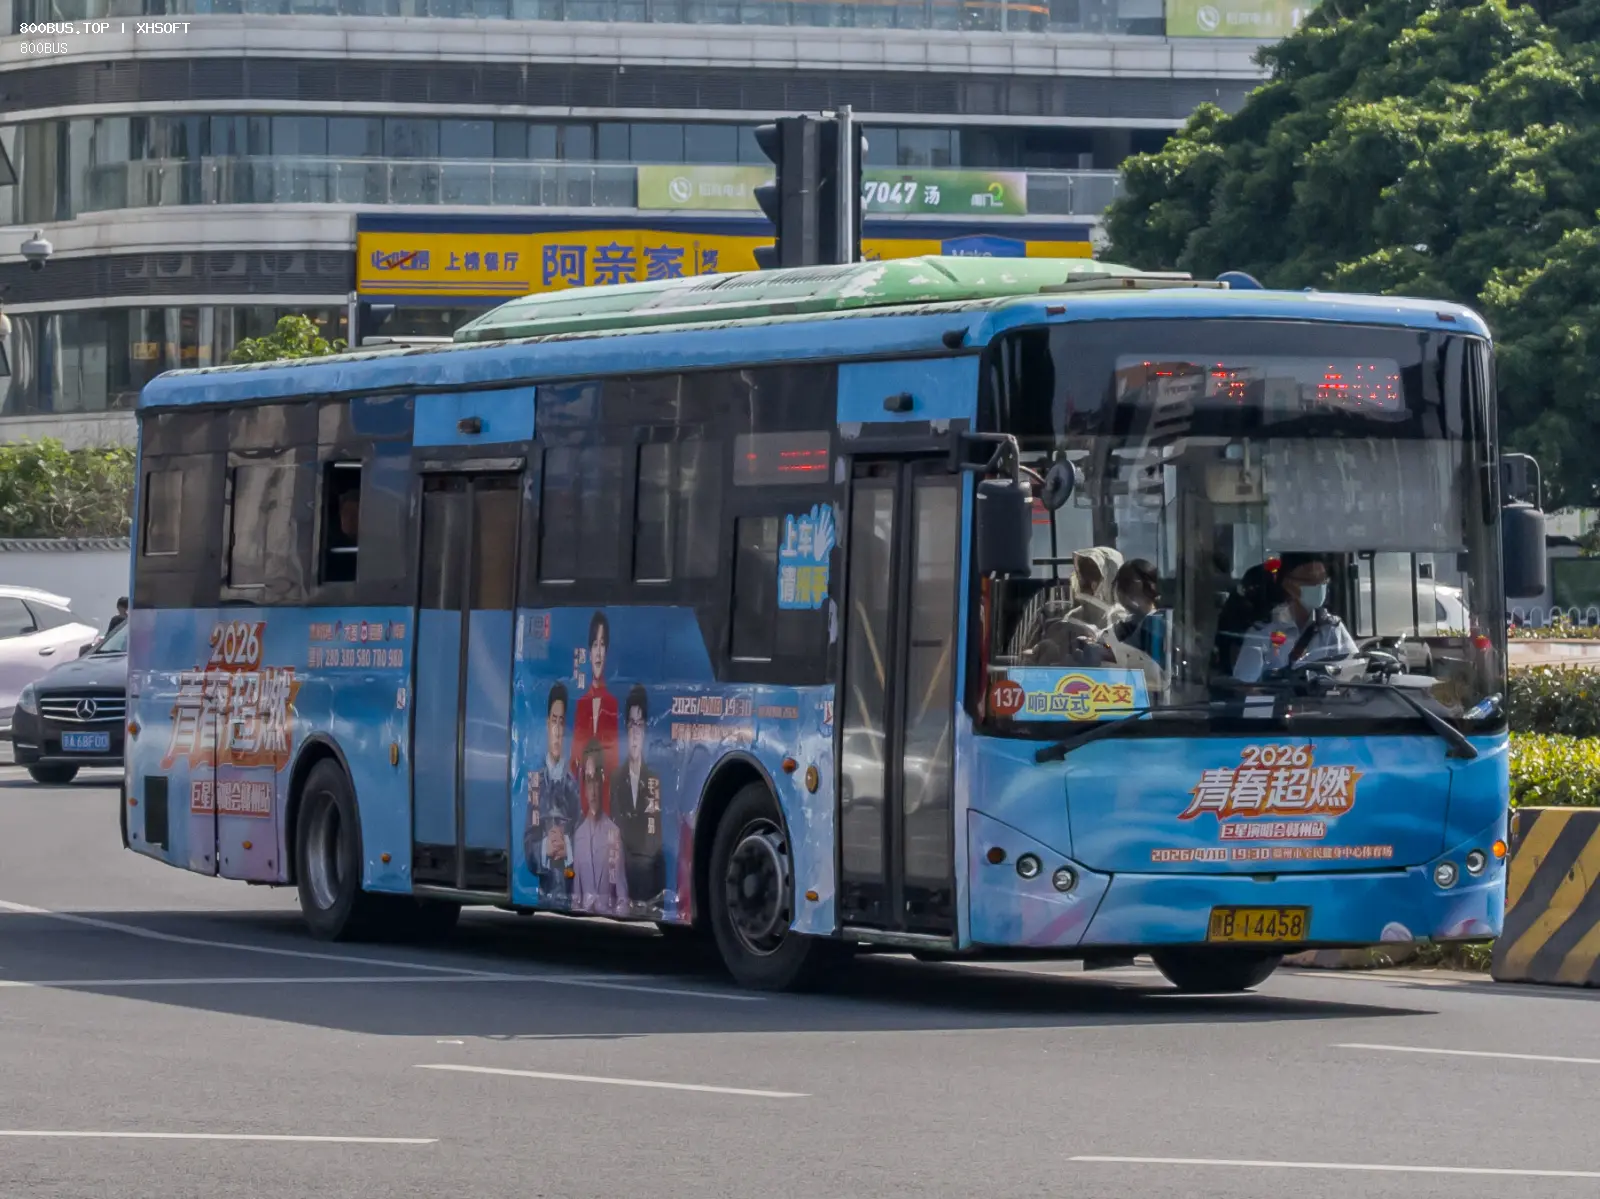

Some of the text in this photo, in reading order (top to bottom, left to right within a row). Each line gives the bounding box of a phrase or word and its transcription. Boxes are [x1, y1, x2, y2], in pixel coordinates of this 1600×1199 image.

[542, 241, 685, 287] 阿亲家
[781, 519, 813, 558] 上车
[211, 623, 259, 664] 2026
[168, 668, 291, 756] 青春超燃
[994, 688, 1022, 707] 137
[1243, 746, 1308, 766] 2026
[1186, 766, 1350, 815] 青春超燃
